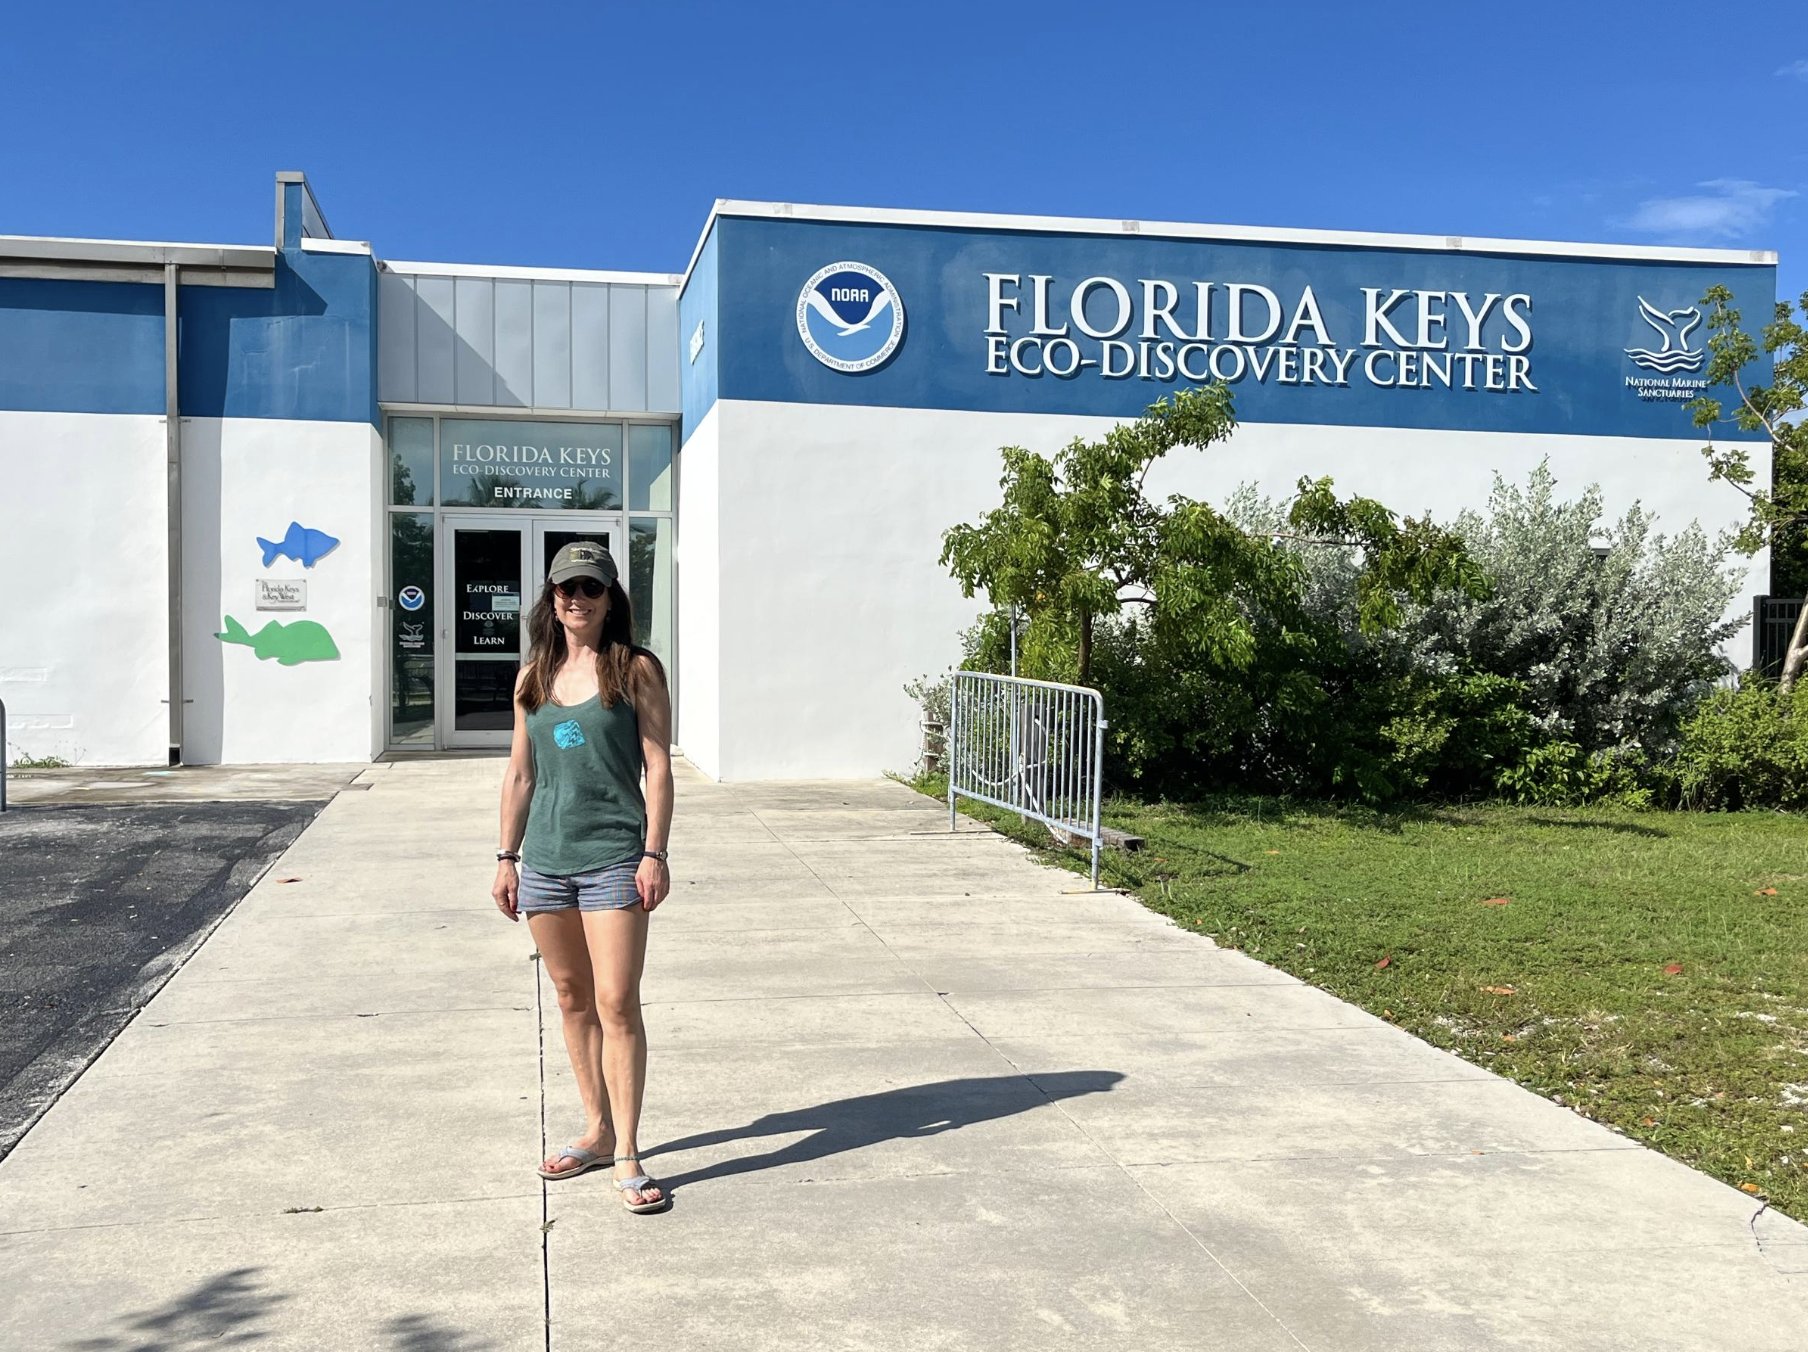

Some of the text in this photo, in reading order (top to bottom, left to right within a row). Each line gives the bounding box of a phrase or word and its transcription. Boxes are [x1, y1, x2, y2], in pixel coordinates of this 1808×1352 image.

[798, 263, 902, 338] NATIONAL OCEANIC AND ATMOSPHERIC ADMINISTRATION
[831, 288, 869, 302] NOAA
[982, 272, 1532, 353] FLORIDA KEYS
[813, 348, 855, 370] DEPARTMENT
[856, 362, 865, 370] OF
[866, 340, 896, 367] COMMERCE
[984, 336, 1538, 390] ECO-DISCOVERY CENTER
[1625, 376, 1706, 388] NATIONAL MARINE
[1638, 387, 1694, 398] SANCTUARIES
[453, 444, 611, 466] FLORIDA KEYS
[453, 464, 611, 478] ECO-DISCOVERY CENTER
[494, 486, 573, 499] ENTRANCE
[463, 611, 514, 620] DISCOVER
[473, 636, 505, 645] LEARN
